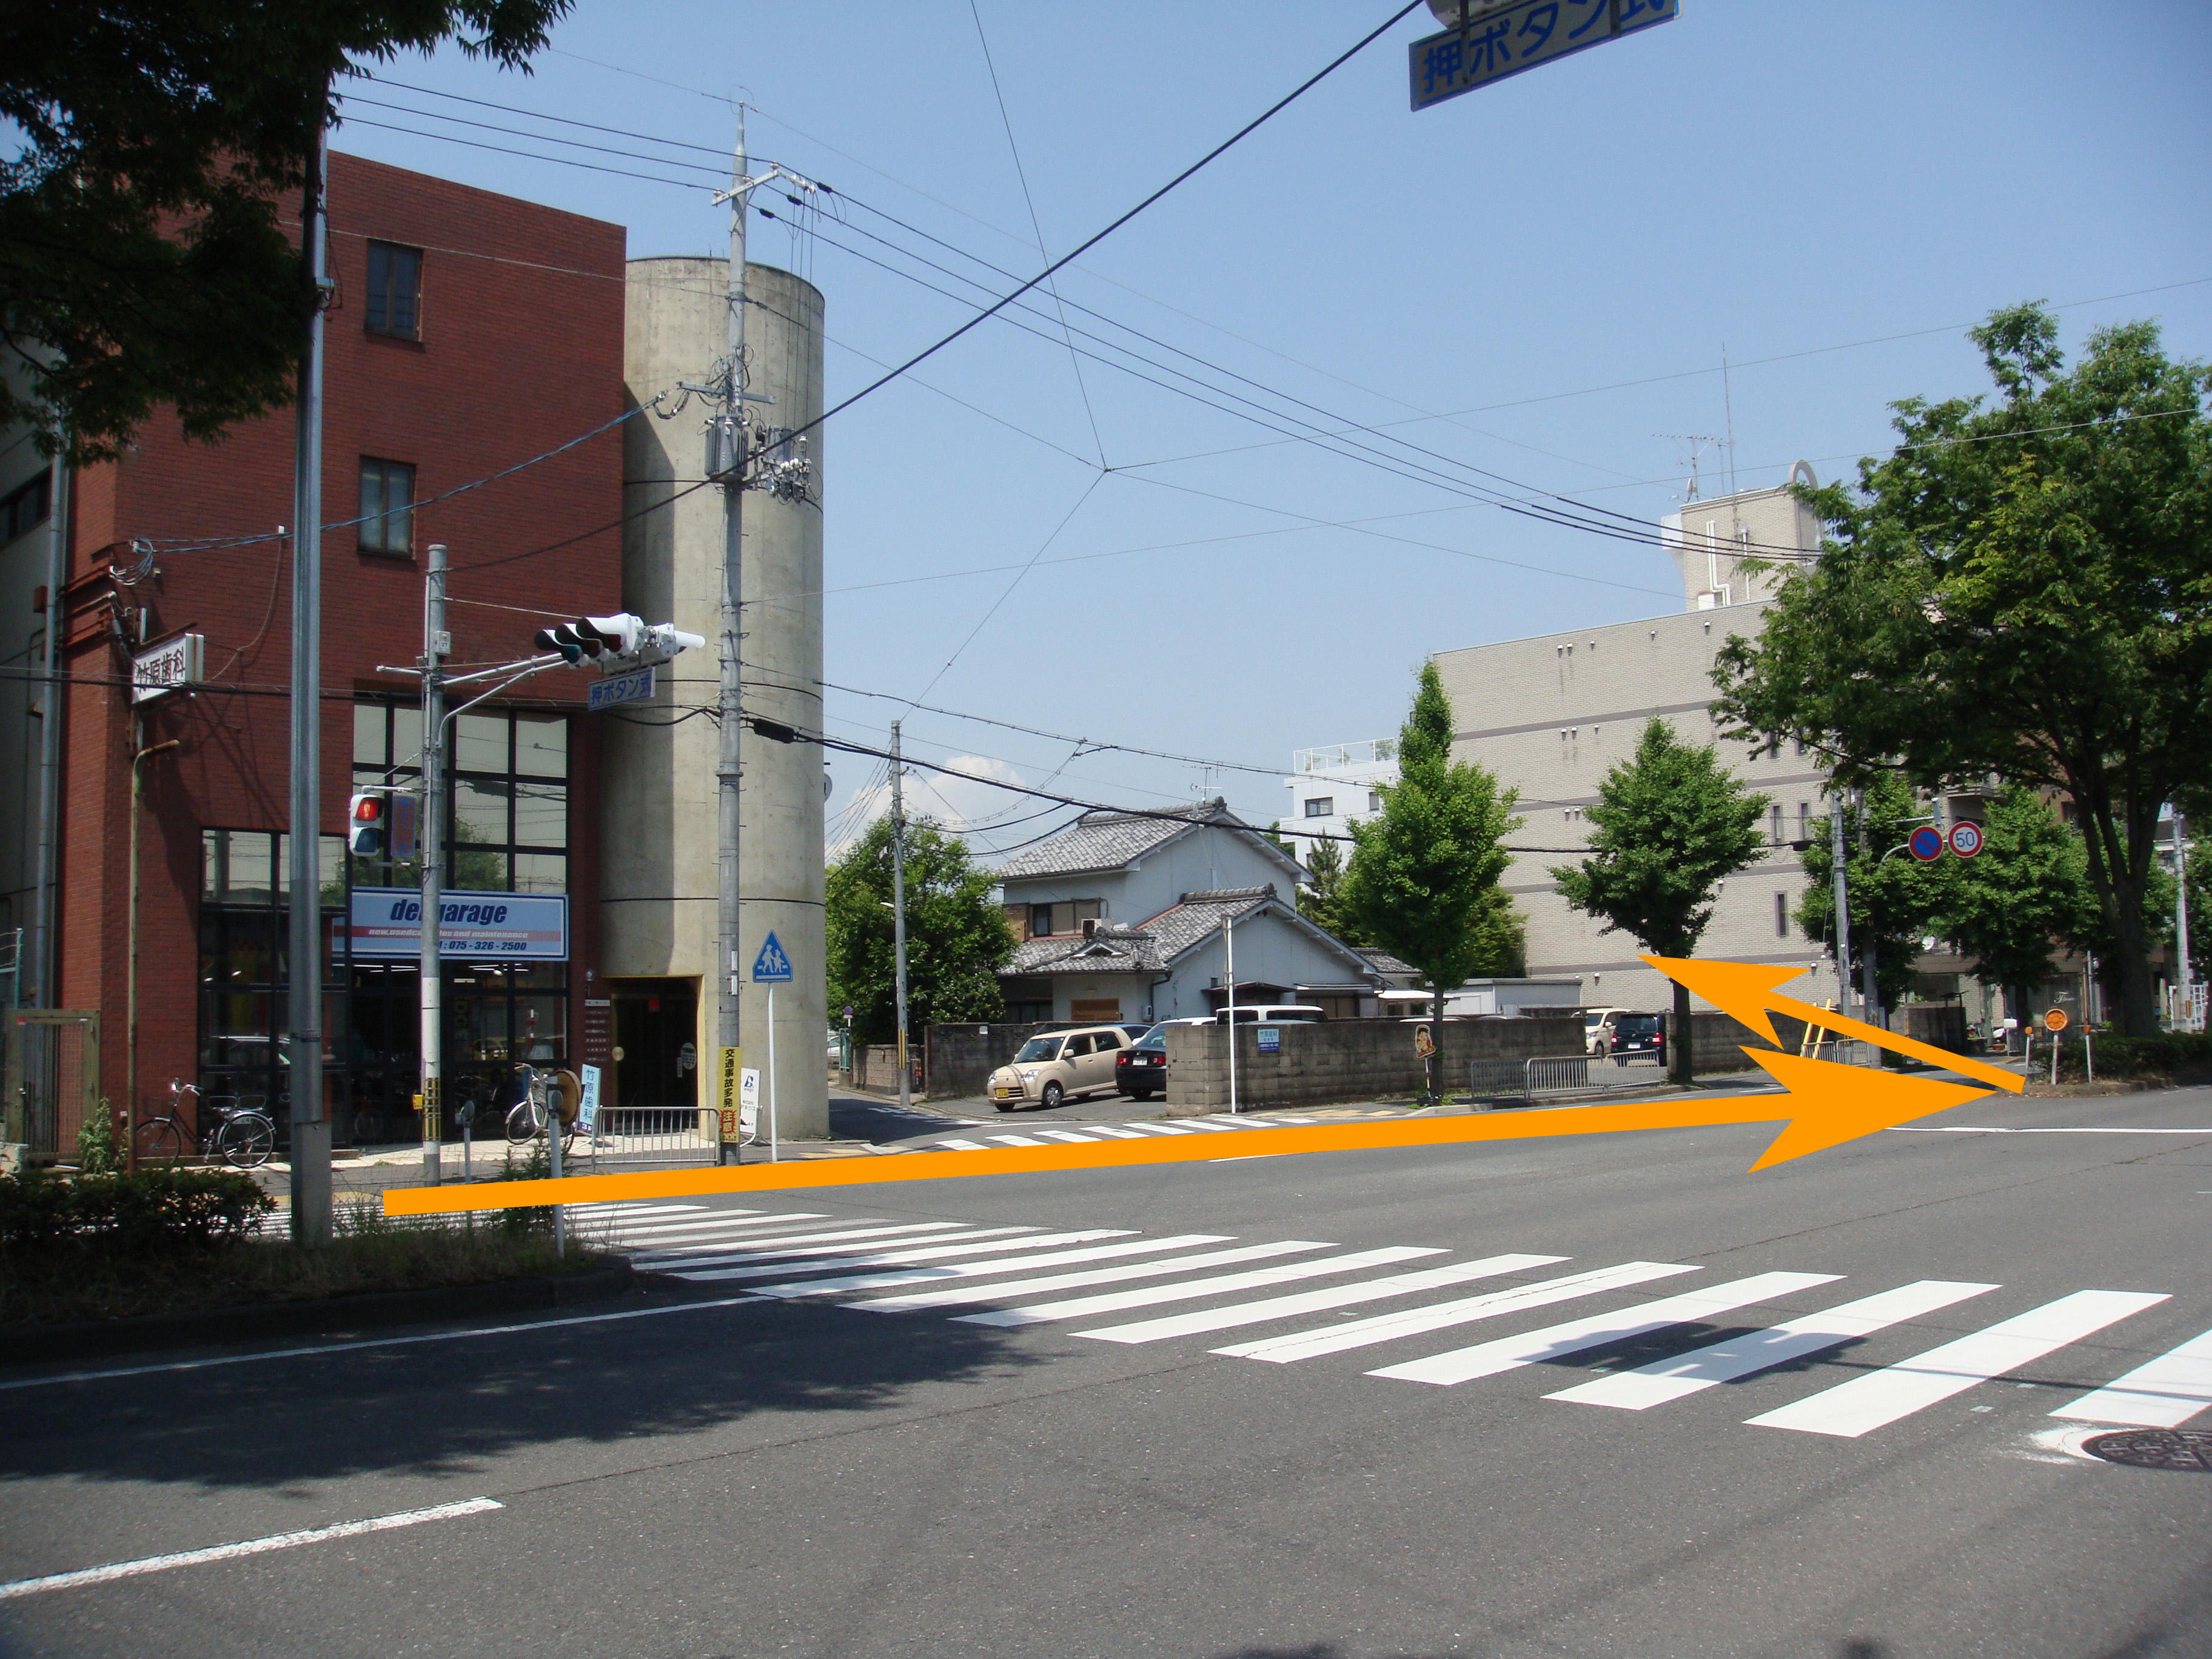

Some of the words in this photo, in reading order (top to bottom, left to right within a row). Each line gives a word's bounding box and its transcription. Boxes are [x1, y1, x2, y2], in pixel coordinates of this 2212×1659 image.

[591, 674, 651, 705] 押ボタン式
[1956, 832, 1974, 847] 50
[584, 1068, 595, 1121] 竹原歯科
[723, 1048, 735, 1108] 交通事故多発
